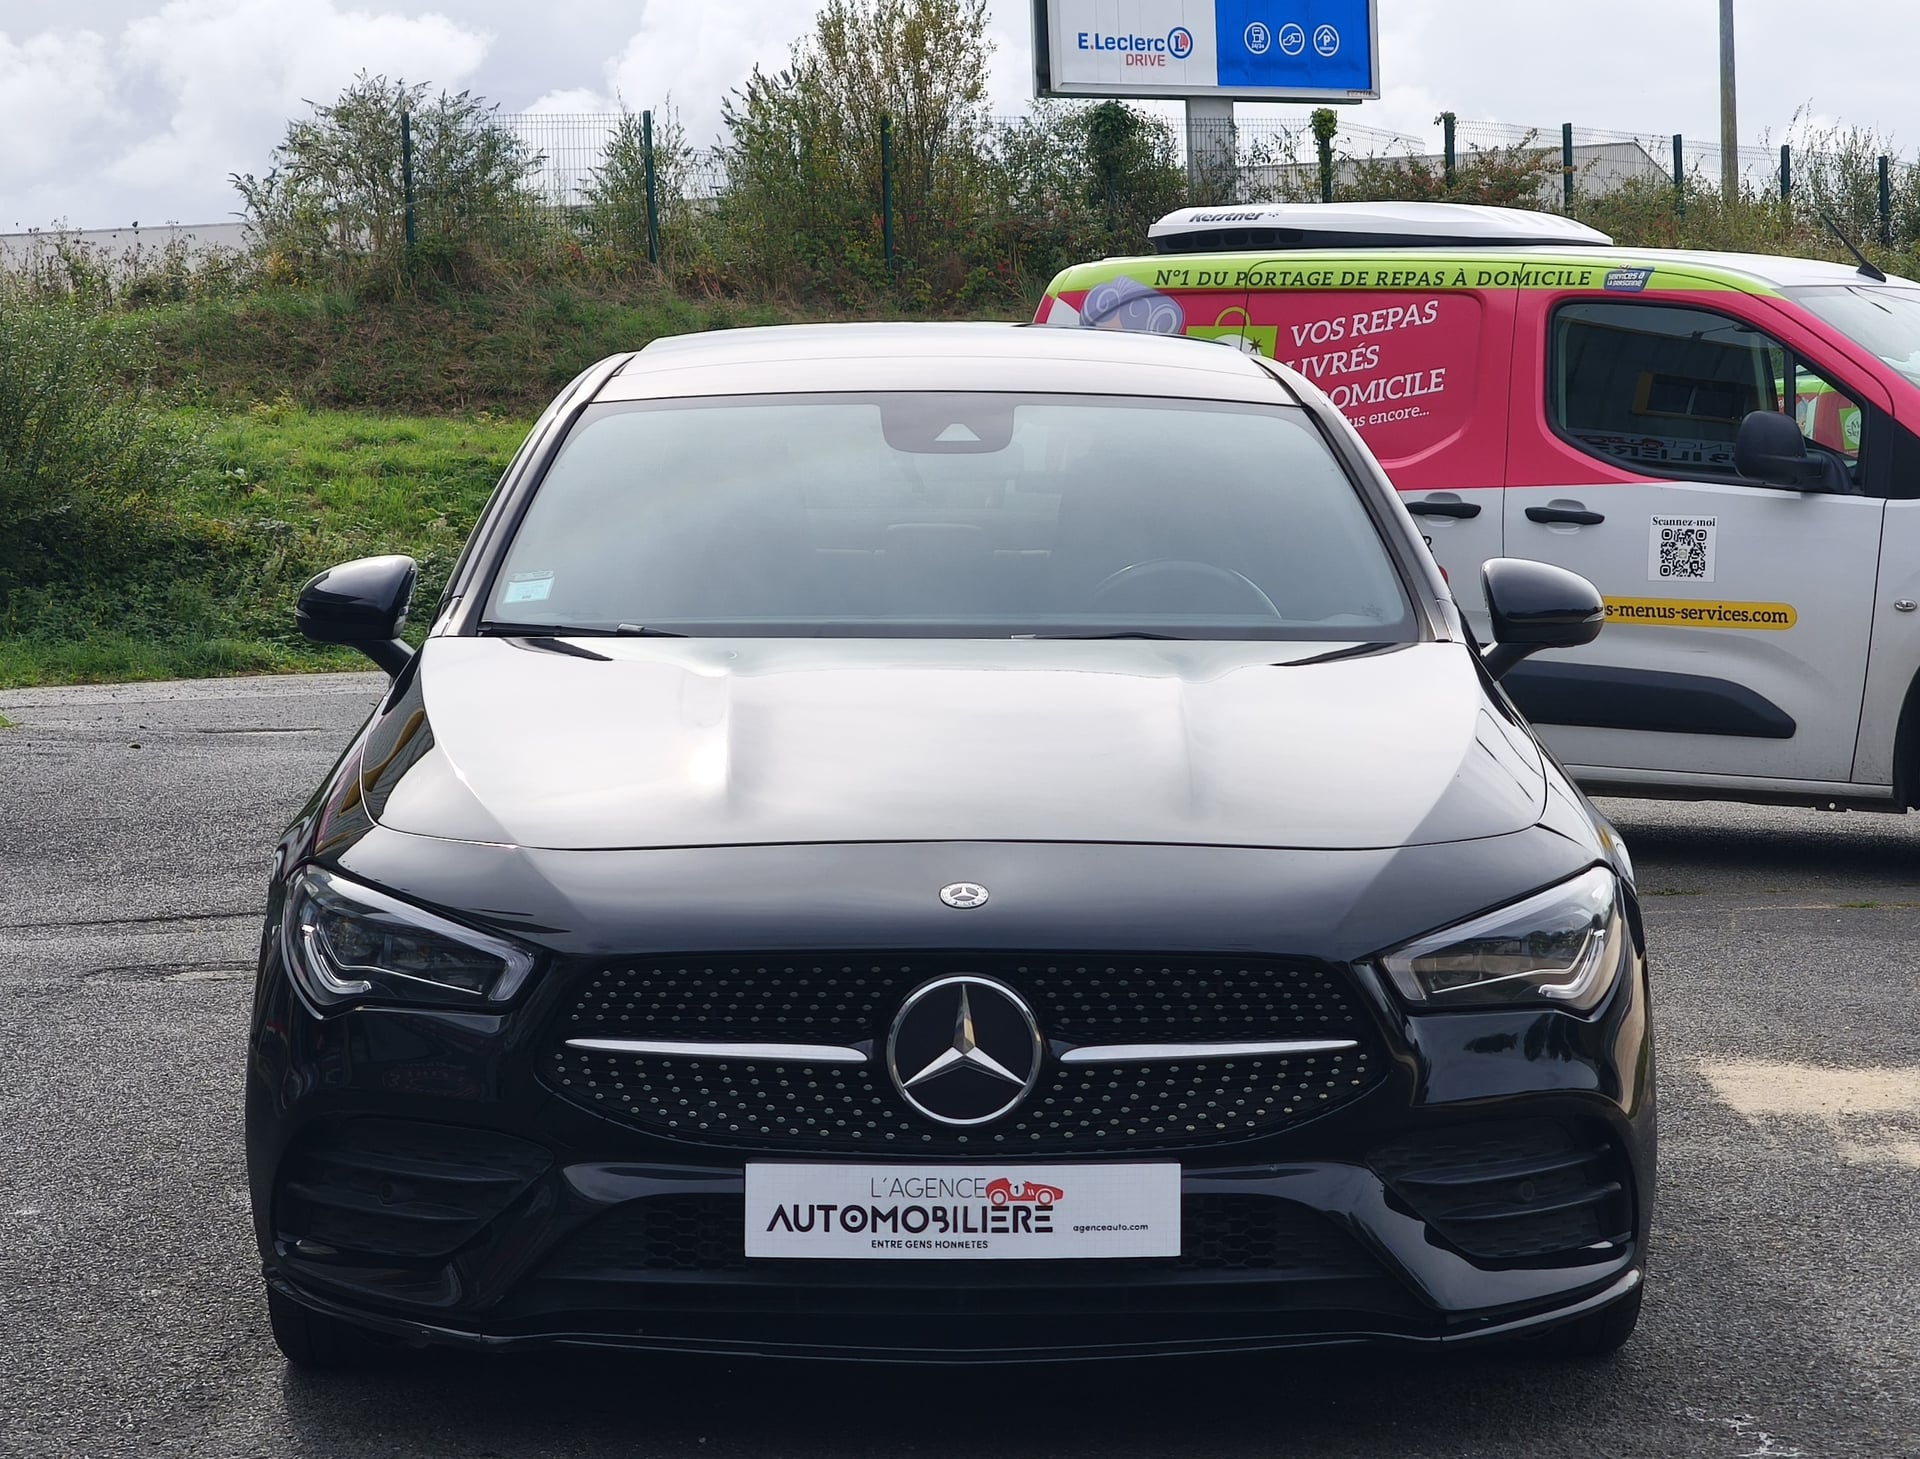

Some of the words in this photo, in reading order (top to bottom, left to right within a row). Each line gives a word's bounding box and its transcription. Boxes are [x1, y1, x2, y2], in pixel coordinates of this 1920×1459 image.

[1078, 32, 1165, 52] E.Leclerc
[1125, 53, 1166, 67] DRIVE
[1197, 271, 1229, 286] DU
[1234, 271, 1333, 287] PORTAGE
[1339, 271, 1369, 287] DE
[1375, 271, 1446, 287] REPAS
[1451, 267, 1468, 287] À
[1475, 271, 1592, 287] DOMICILE
[1290, 317, 1346, 347] VOS
[1350, 300, 1439, 338] REPAS
[1321, 368, 1446, 410] OMICILE
[1652, 516, 1716, 527] Scannez-moi
[1072, 1224, 1149, 1234] agenceauto.com
[871, 1240, 902, 1249] ENTRE
[905, 1240, 933, 1249] GENS
[935, 1240, 988, 1249] HONNETES
